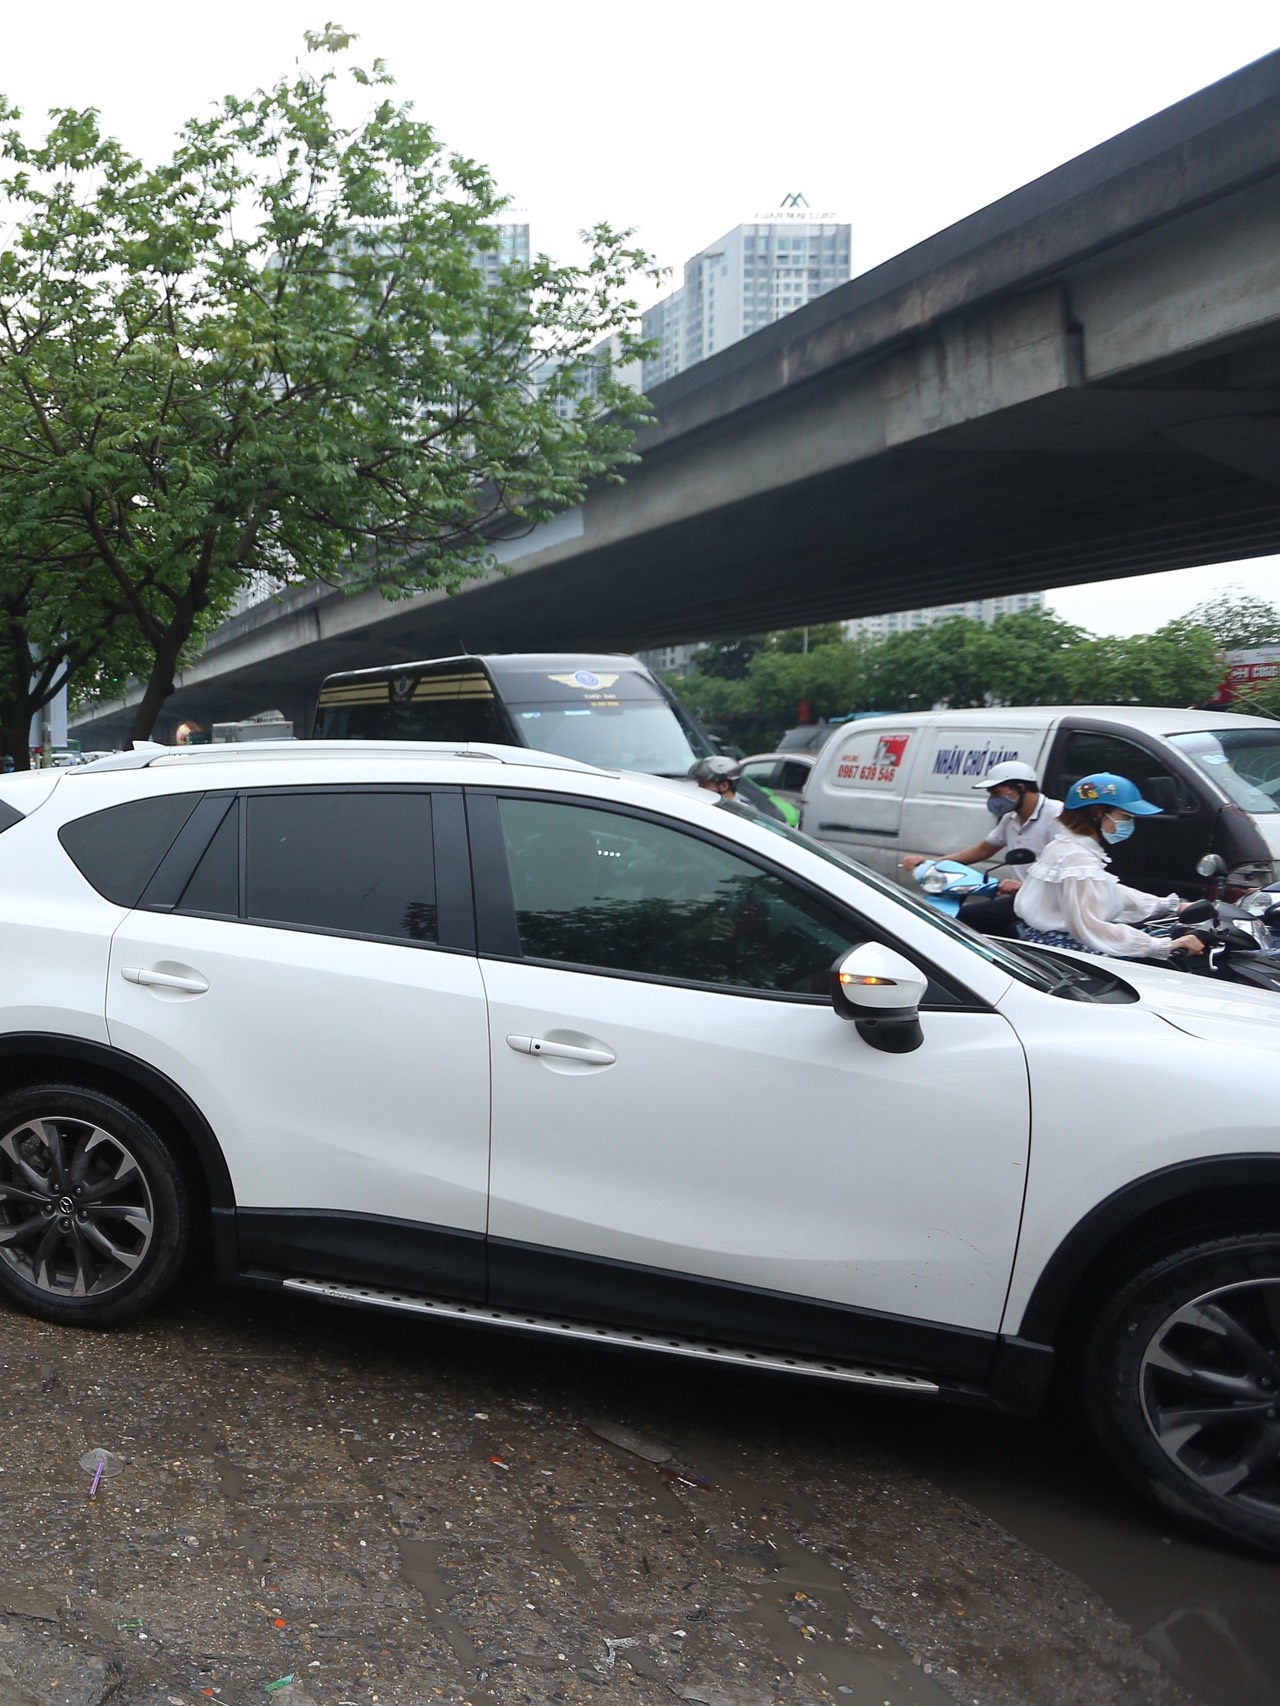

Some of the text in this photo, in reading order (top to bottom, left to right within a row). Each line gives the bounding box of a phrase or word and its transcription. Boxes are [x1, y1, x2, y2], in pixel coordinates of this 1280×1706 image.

[838, 764, 896, 782] 0967 639 546
[932, 745, 965, 779] NHẬN
